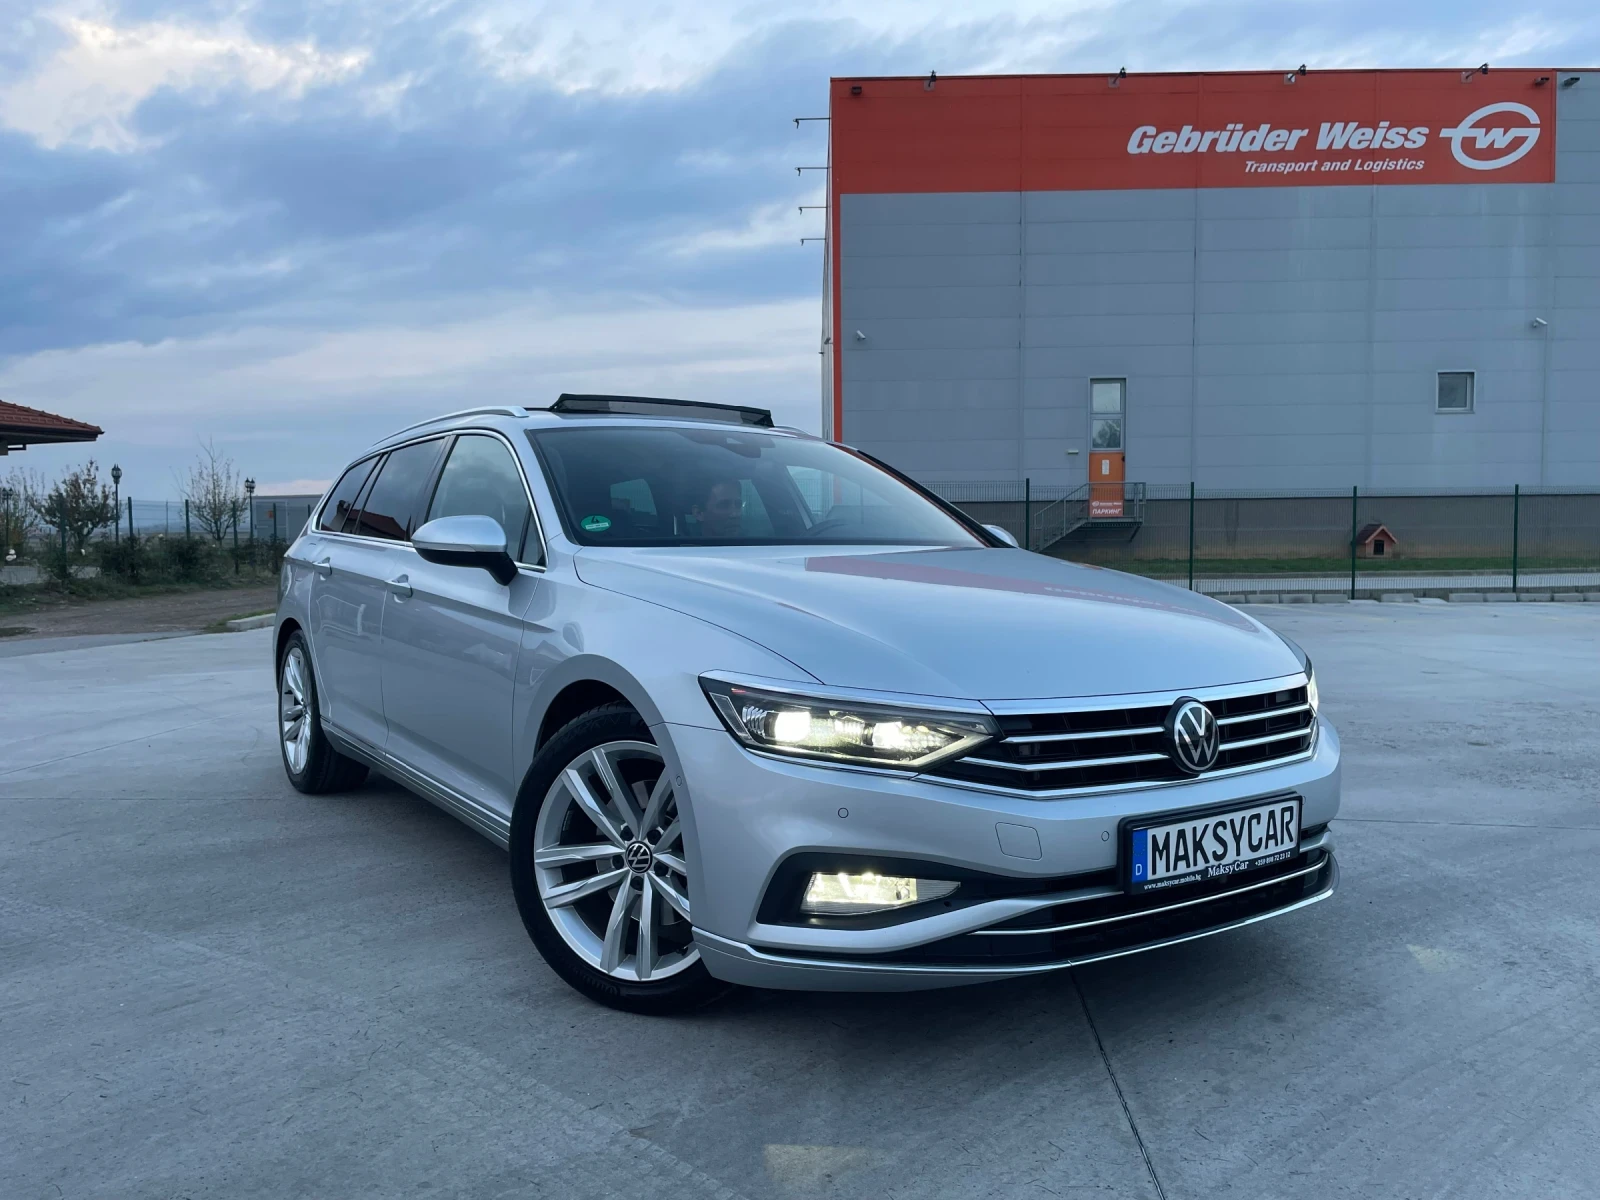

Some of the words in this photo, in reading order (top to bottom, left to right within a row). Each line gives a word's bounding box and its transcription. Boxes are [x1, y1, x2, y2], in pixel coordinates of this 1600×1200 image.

[1127, 123, 1309, 154] Gebrüder
[1315, 121, 1430, 150] Weiss
[1244, 160, 1318, 174] Transport
[1320, 159, 1352, 172] and
[1354, 158, 1425, 173] Logistics
[1151, 805, 1294, 876] MAKSYCAR
[1135, 863, 1143, 876] D
[1207, 861, 1249, 878] MaksyCar
